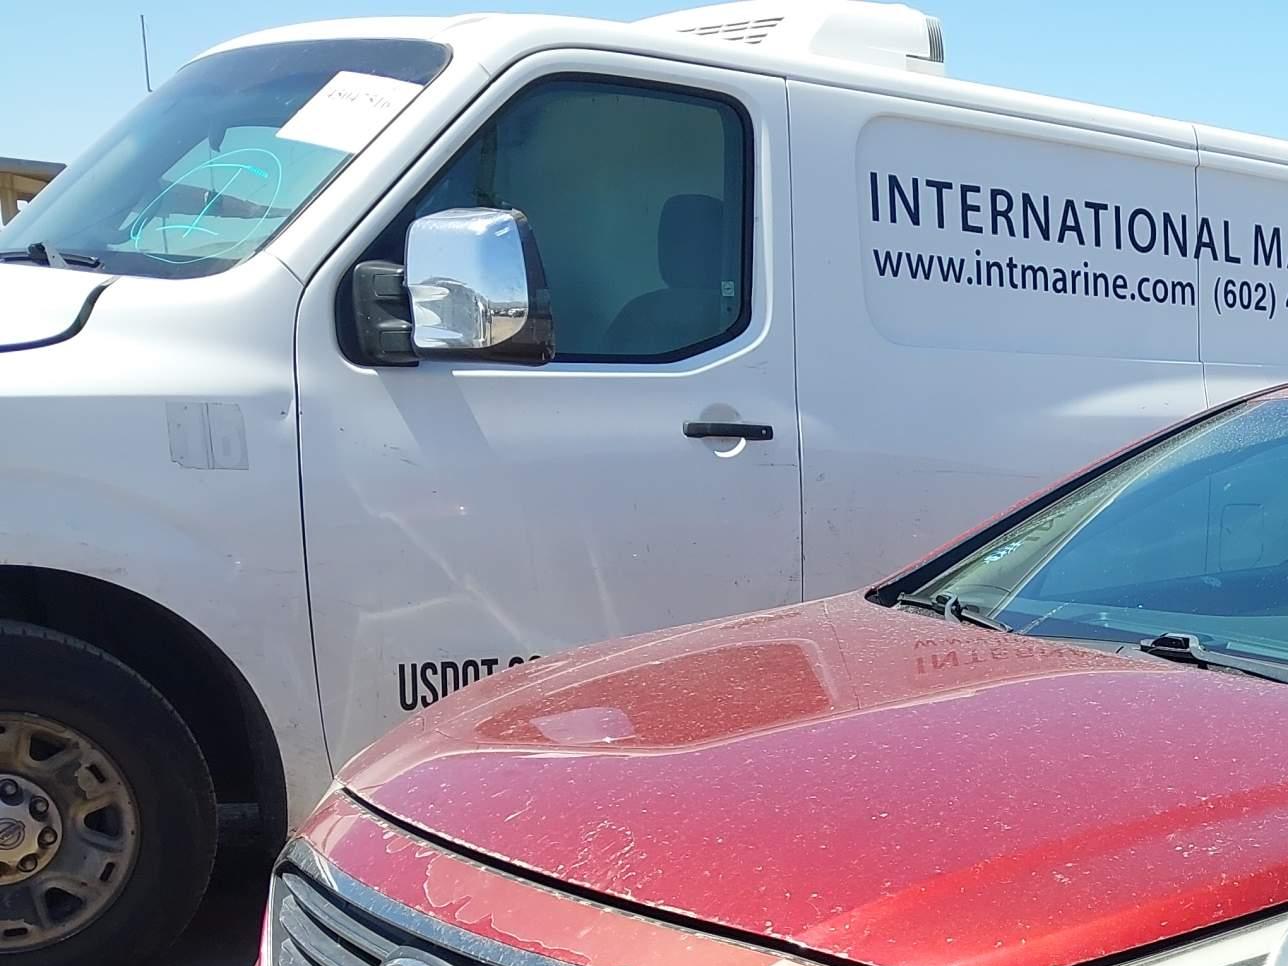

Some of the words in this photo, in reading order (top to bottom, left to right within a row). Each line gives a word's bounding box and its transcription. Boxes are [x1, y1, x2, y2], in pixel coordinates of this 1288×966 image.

[869, 170, 1240, 263] INTERNATIONAL
[873, 246, 1196, 307] www.intmarine.com
[1213, 276, 1278, 319] (602)
